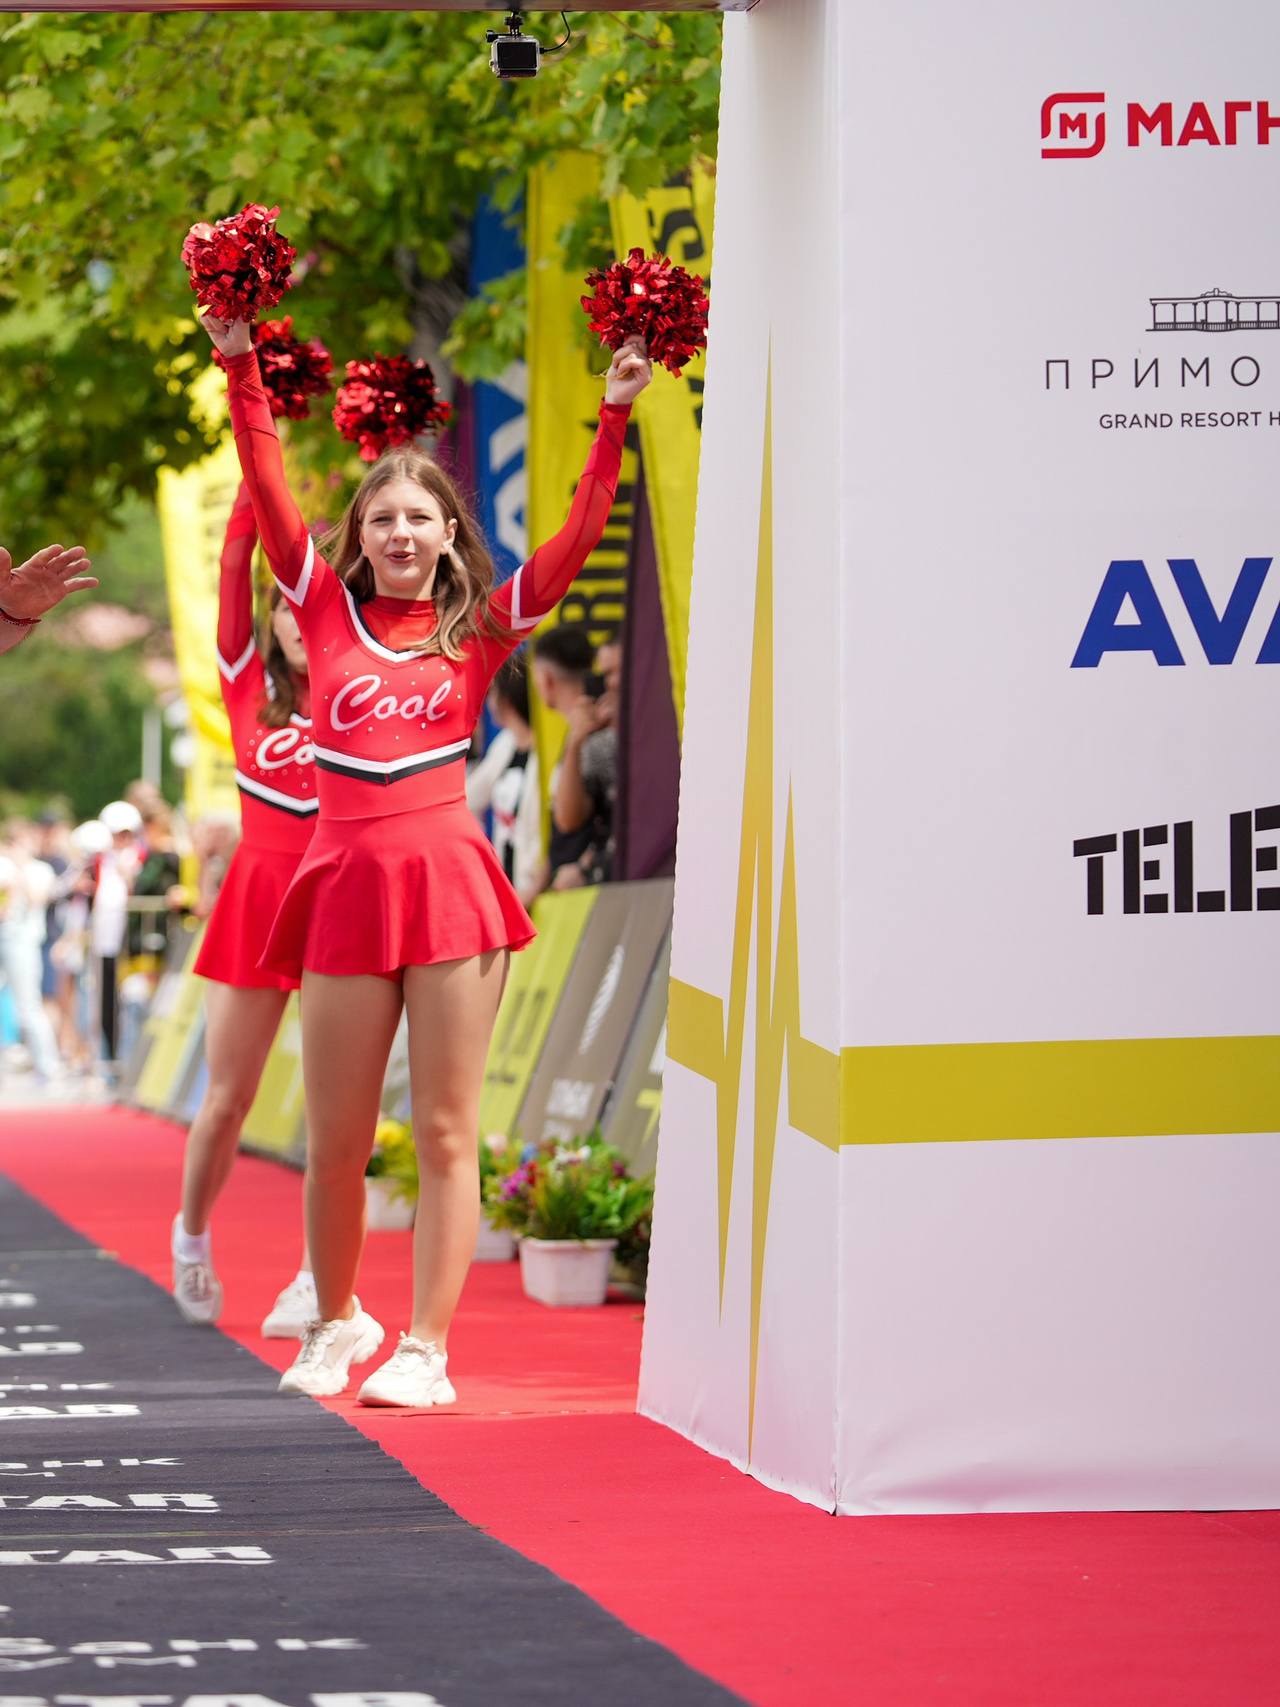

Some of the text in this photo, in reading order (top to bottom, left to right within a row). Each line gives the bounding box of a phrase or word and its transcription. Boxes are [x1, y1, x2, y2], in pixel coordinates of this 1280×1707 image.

[1045, 355, 1261, 390] ПРИМО
[1099, 412, 1174, 430] GRAND
[1180, 411, 1262, 428] RESORT
[1070, 557, 1280, 668] AV
[330, 674, 452, 732] Cool
[255, 727, 317, 771] Co
[1073, 804, 1280, 915] TELE
